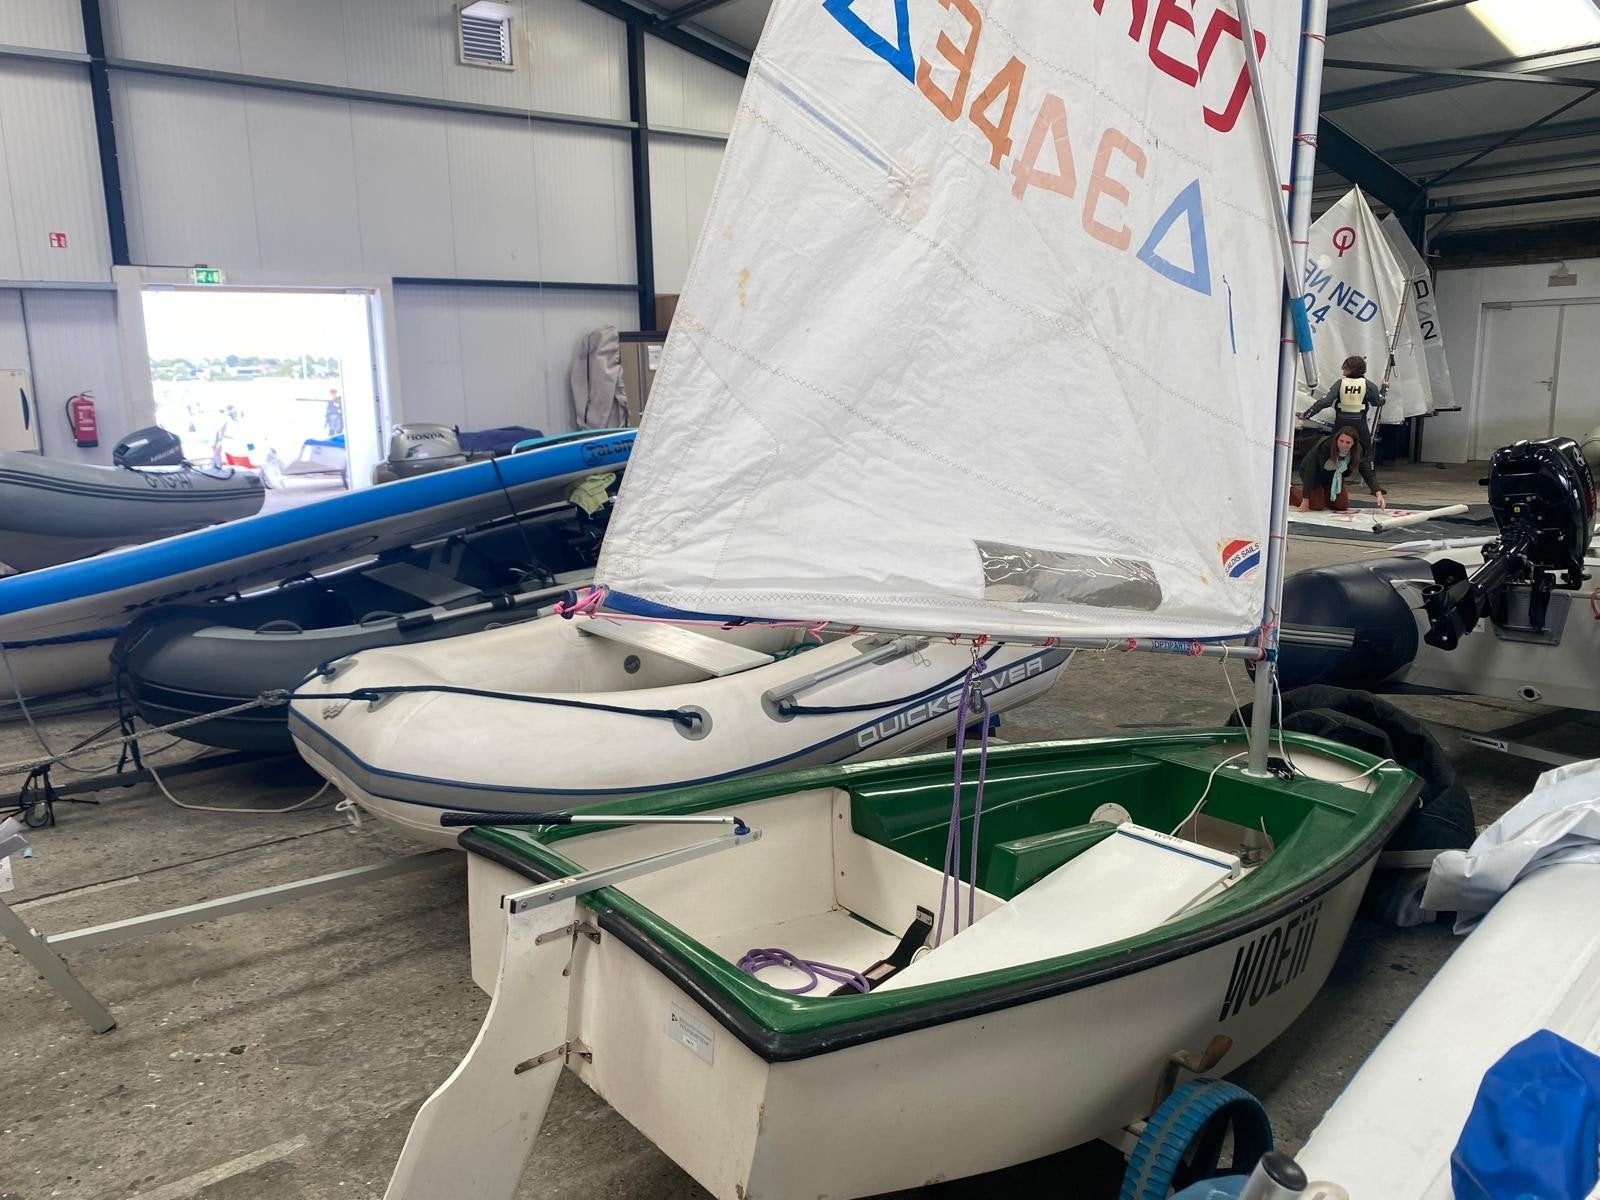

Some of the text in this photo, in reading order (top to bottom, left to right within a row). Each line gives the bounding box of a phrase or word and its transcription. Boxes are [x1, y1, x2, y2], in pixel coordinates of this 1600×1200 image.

[1092, 0, 1267, 133] ED
[1327, 280, 1378, 323] NED
[1344, 385, 1362, 394] HH
[406, 431, 445, 441] HONDA
[857, 657, 1043, 749] QUICKSVER
